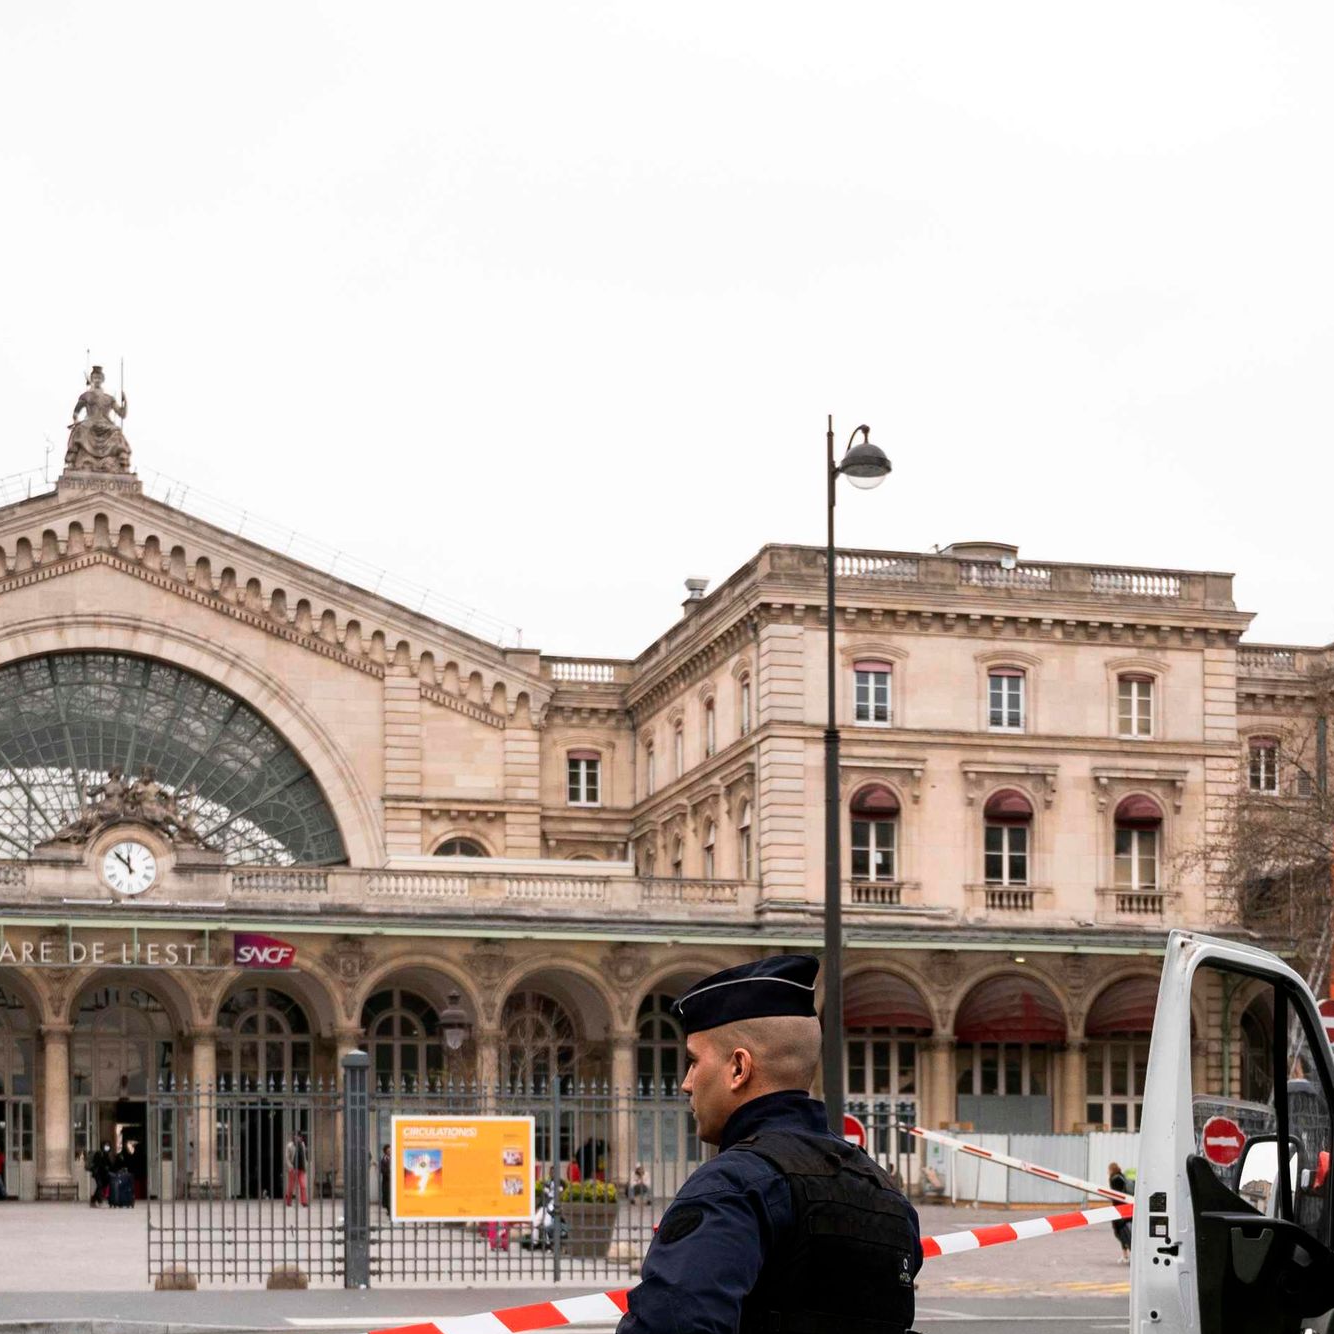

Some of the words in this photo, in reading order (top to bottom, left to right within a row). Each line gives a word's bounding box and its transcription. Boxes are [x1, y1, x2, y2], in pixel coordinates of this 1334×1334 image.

[69, 942, 106, 963] DE
[122, 943, 197, 965] L'EST
[236, 946, 293, 964] SNCF
